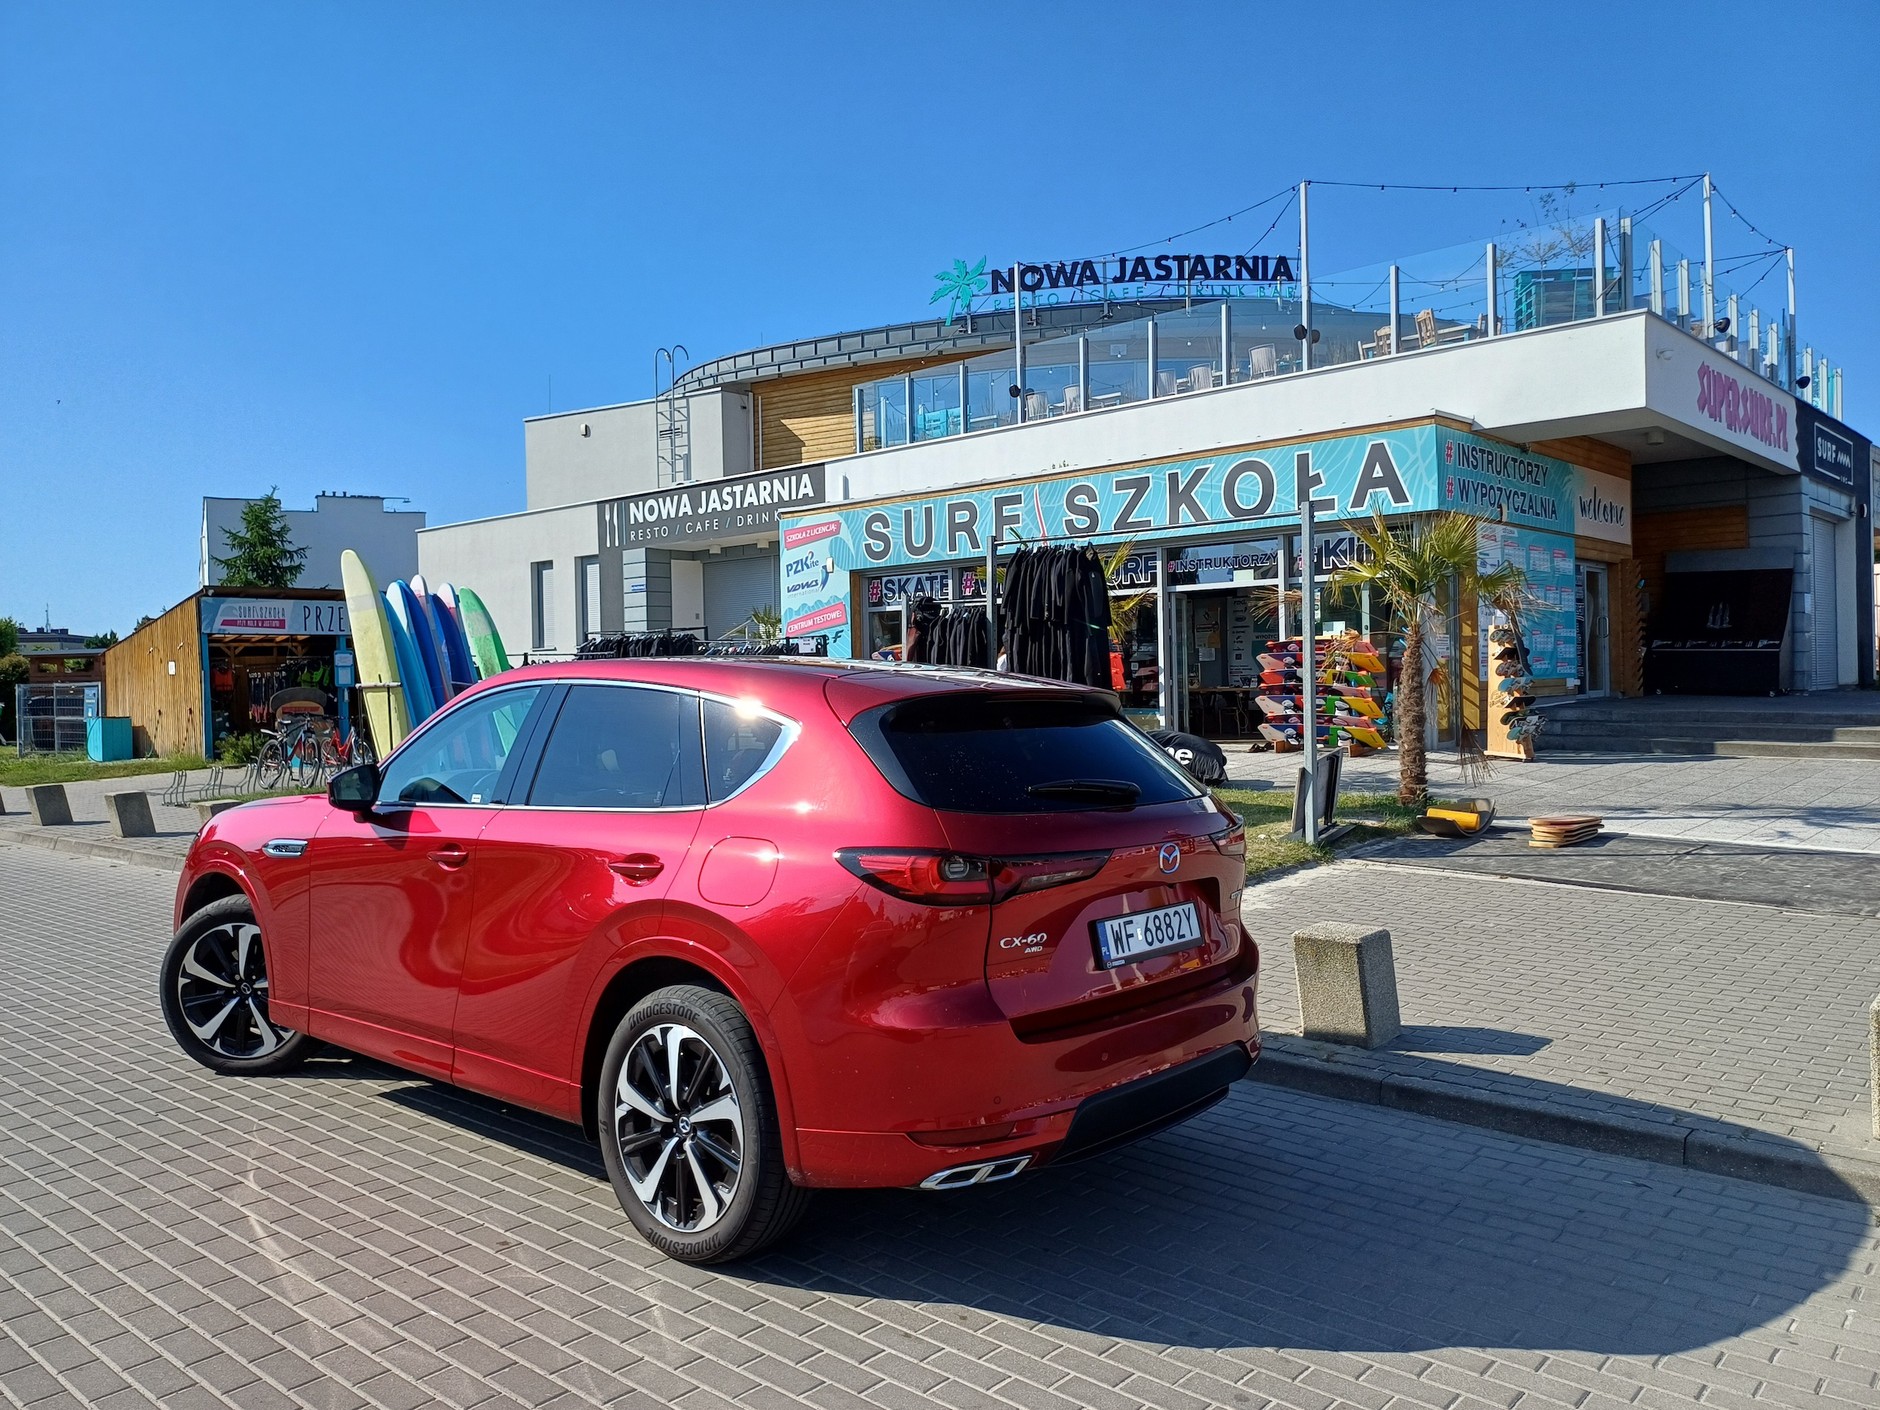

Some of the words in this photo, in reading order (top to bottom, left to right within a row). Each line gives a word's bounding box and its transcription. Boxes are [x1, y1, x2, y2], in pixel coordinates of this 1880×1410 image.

[992, 260, 1099, 293] NOWA
[1112, 254, 1294, 283] JASTARNIA
[994, 292, 1059, 311] RESTO
[1090, 285, 1144, 301] CAFE
[1177, 284, 1246, 298] DRINK
[1257, 284, 1296, 299] BAR
[1817, 436, 1837, 464] SURF
[630, 493, 693, 525] NOWA
[697, 473, 815, 515] JASTARNIA
[863, 491, 1024, 563] SURF
[1063, 439, 1414, 541] SZKOŁA
[1579, 485, 1625, 528] welcome
[630, 527, 669, 542] RESTO
[685, 518, 720, 535] CAFE
[737, 511, 781, 527] DRINK
[303, 605, 351, 632] PRZE
[787, 618, 813, 633] CENTRUM
[1000, 932, 1048, 950] CX-60
[1110, 919, 1135, 956] WF
[1143, 906, 1195, 947] 6882Y
[1024, 945, 1043, 954] AWD
[1101, 946, 1110, 957] PL
[628, 1002, 701, 1031] BRIDGESTONE
[646, 1226, 722, 1257] BRIDGESTONE
